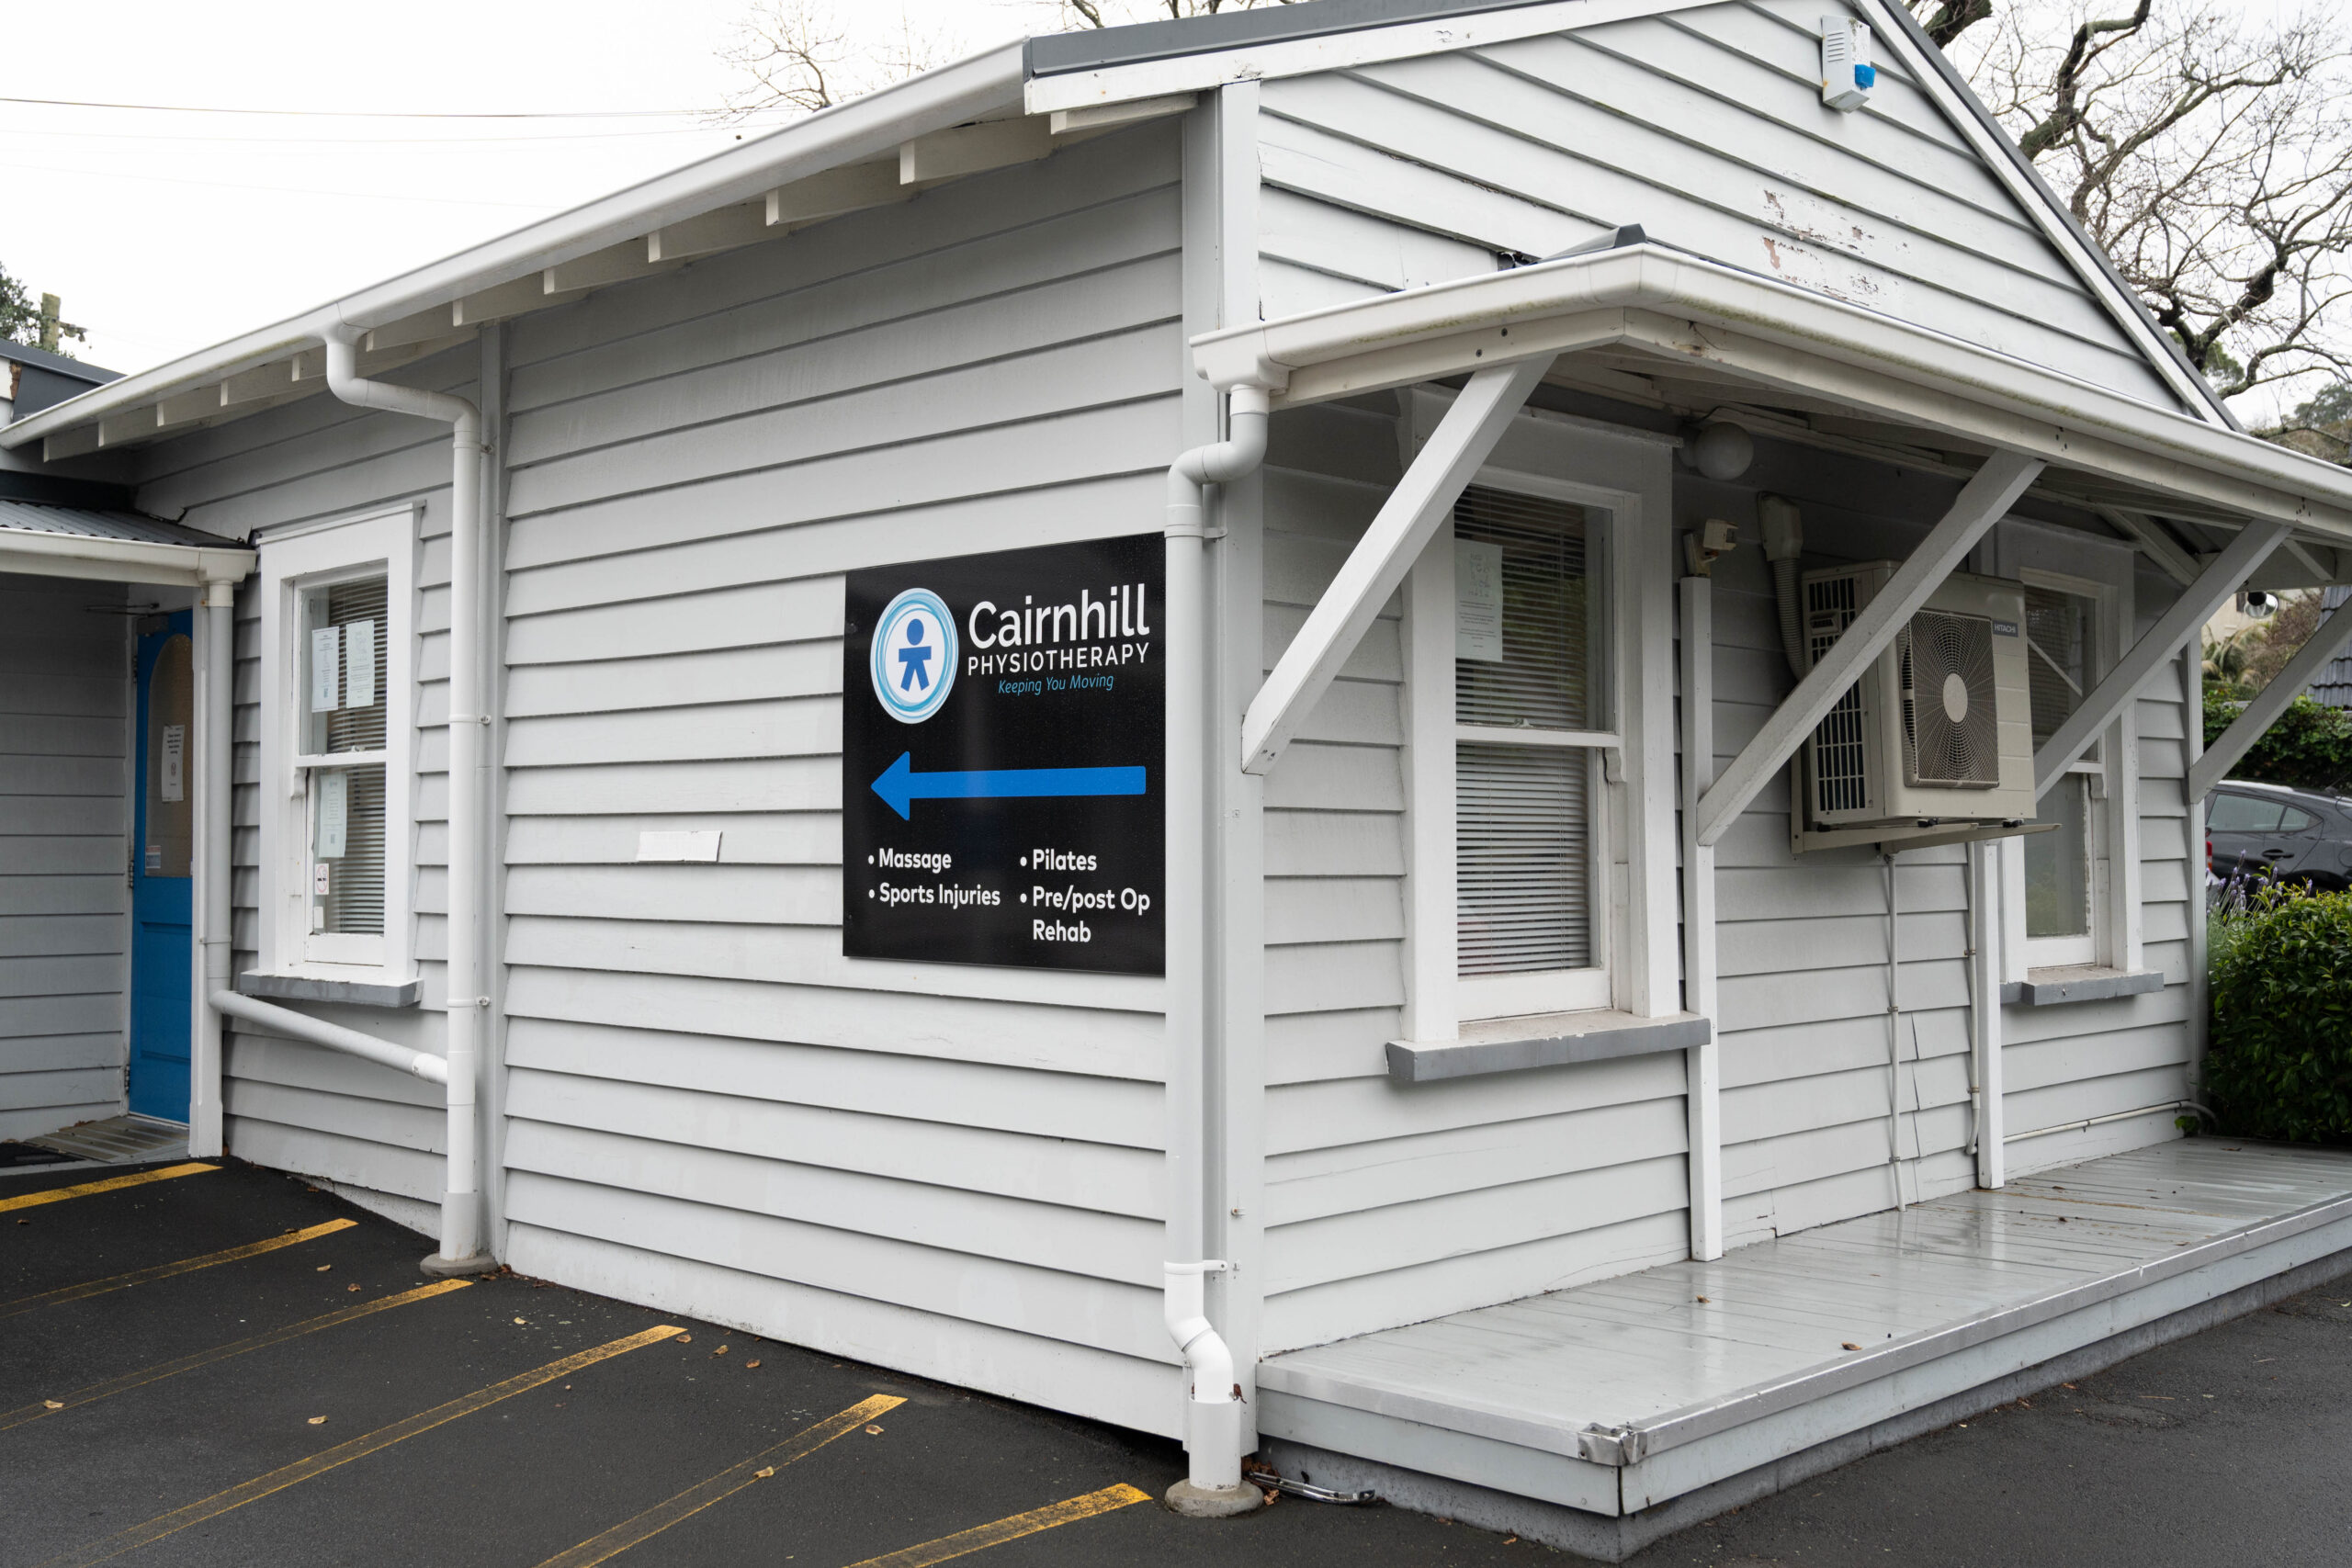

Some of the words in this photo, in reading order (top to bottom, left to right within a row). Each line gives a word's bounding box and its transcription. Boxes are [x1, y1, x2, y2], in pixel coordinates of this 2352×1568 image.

[968, 582, 1150, 649] Cairnhill
[1994, 623, 2017, 634] HITACHI
[967, 642, 1149, 676] PHYSIOTHERAPY
[998, 678, 1043, 696] Keeping
[1046, 675, 1067, 691] You
[1069, 672, 1114, 692] Moving
[878, 847, 952, 874] Massage
[1033, 848, 1098, 871] Pilates
[879, 882, 934, 908] Sports
[938, 883, 1001, 909] Injuries
[1033, 885, 1116, 914] Pre/post
[1120, 887, 1151, 916] Op
[1033, 919, 1091, 942] Rehab
